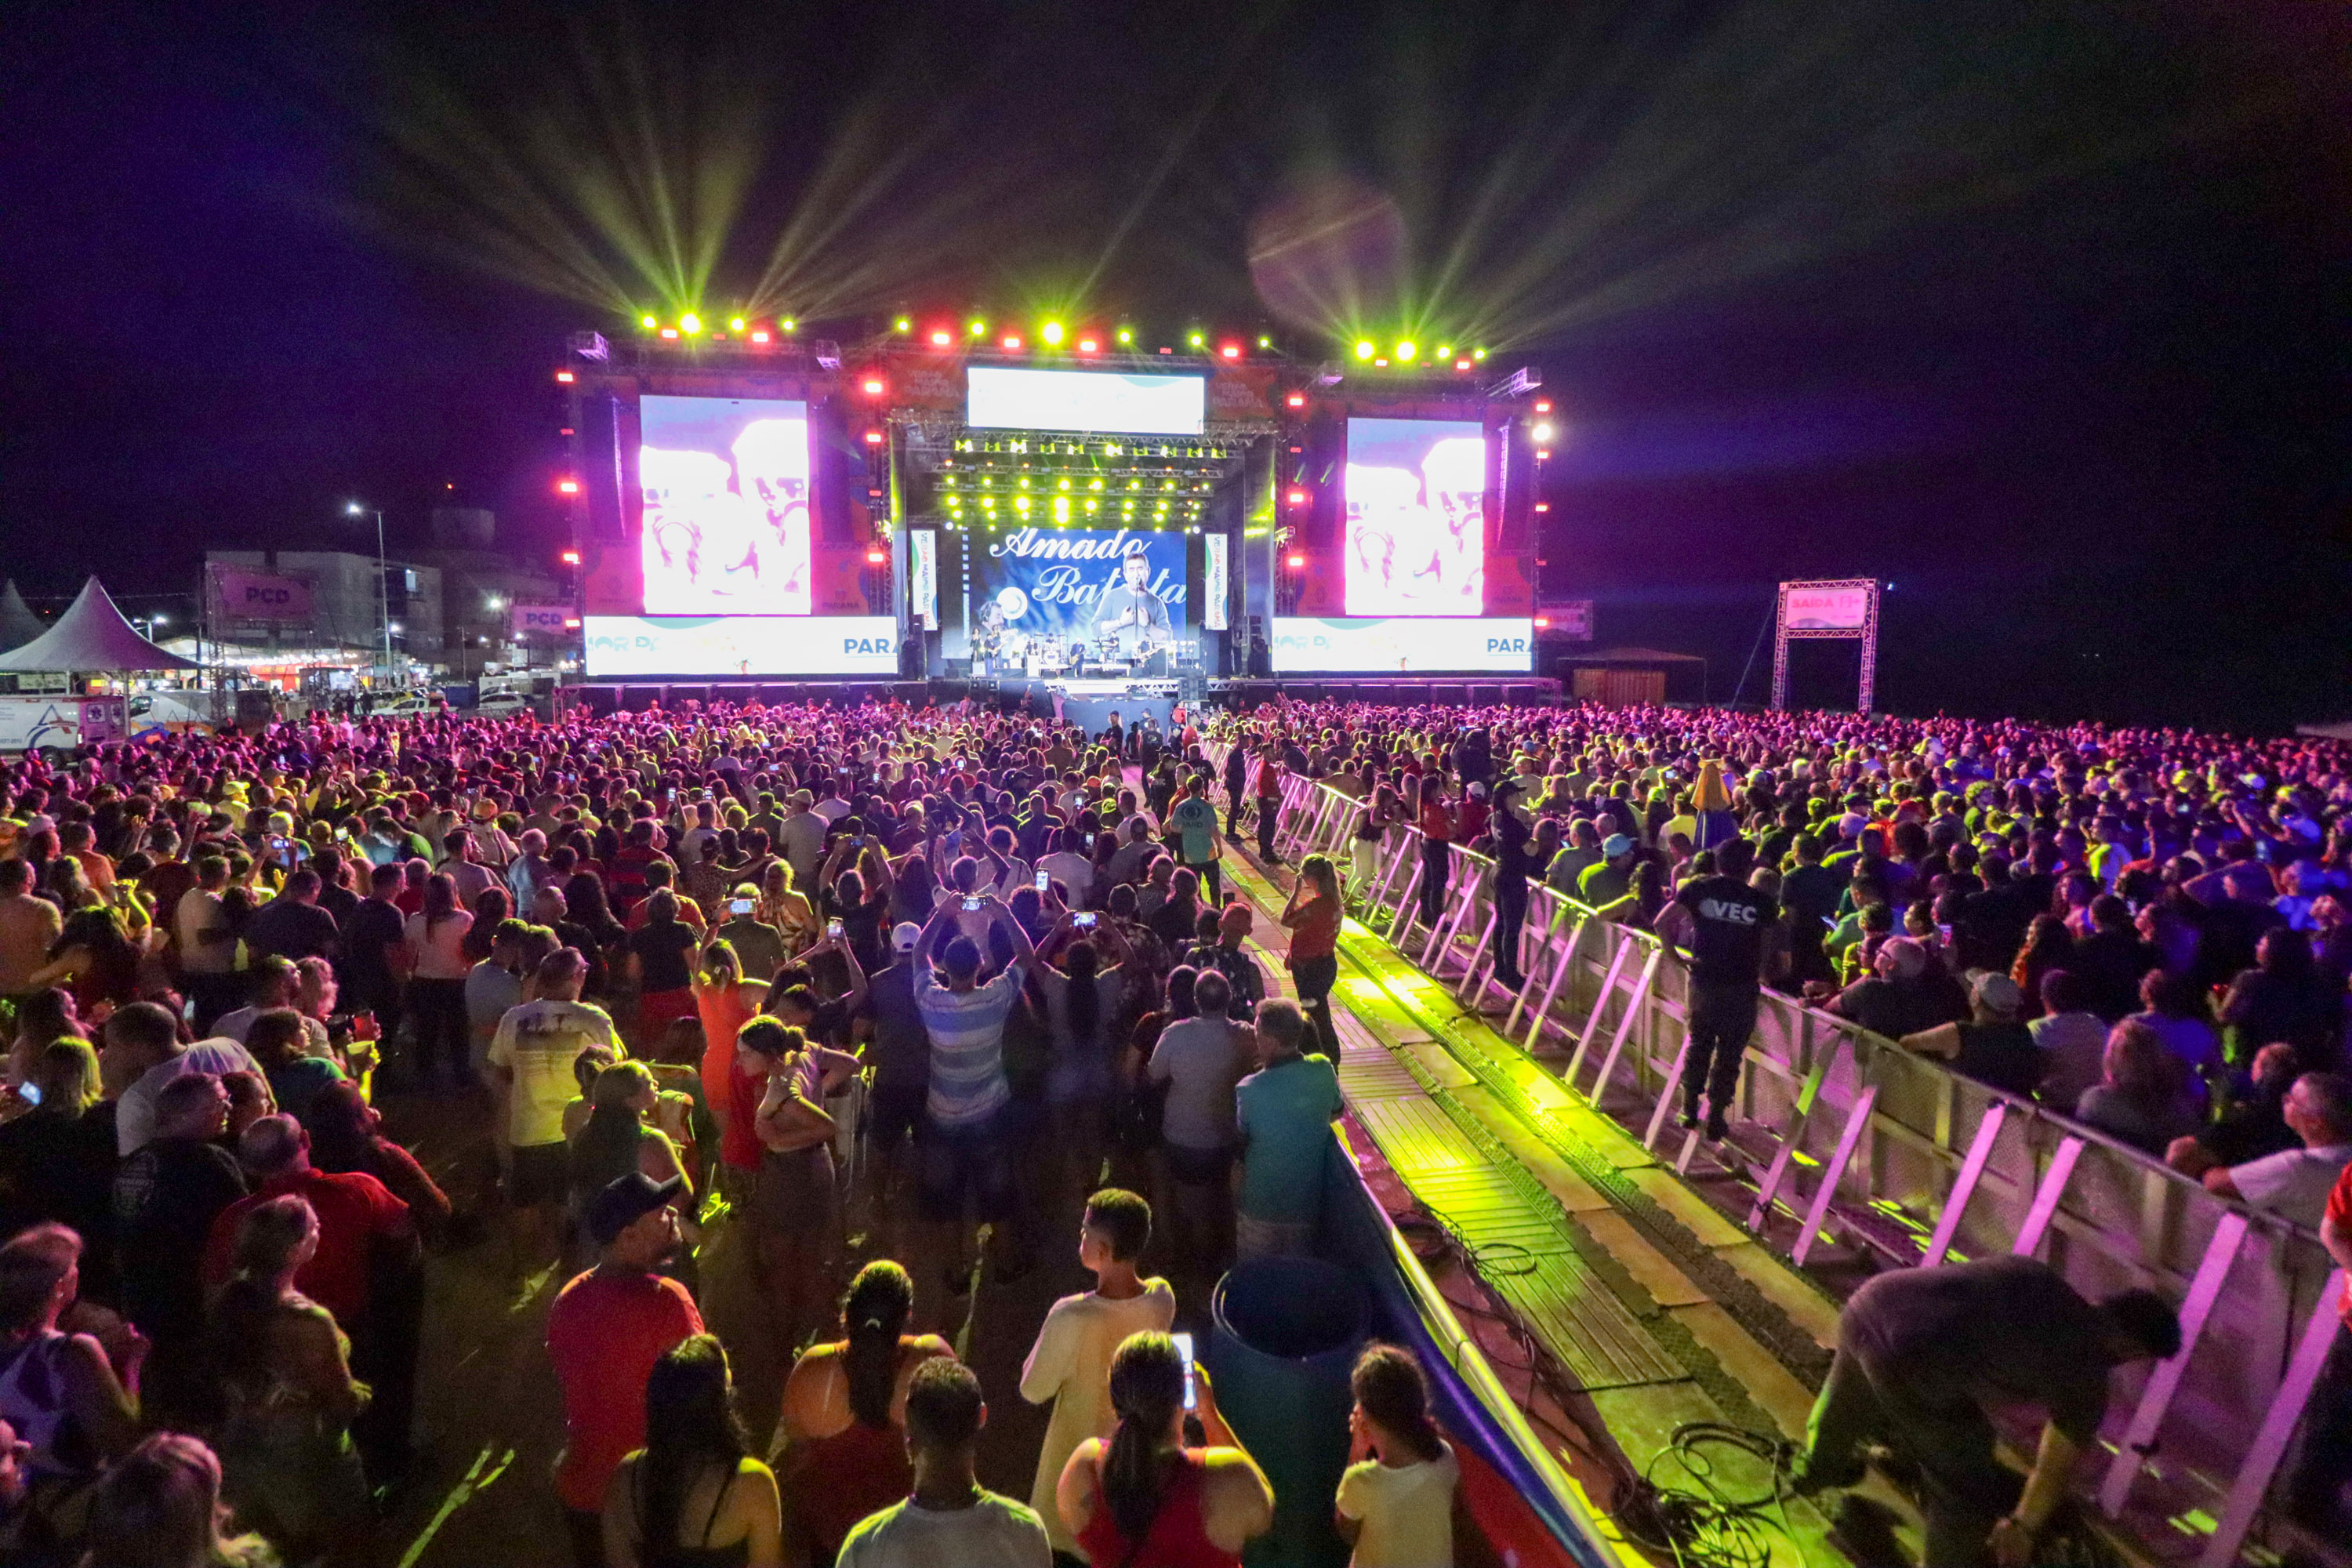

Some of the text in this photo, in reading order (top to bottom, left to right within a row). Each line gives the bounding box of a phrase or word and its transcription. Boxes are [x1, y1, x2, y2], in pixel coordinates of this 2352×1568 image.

[989, 528, 1152, 560] Amado
[245, 587, 289, 604] PCD
[1031, 565, 1186, 604] Batta
[526, 613, 562, 625] PCD
[1712, 898, 1758, 924] VEC
